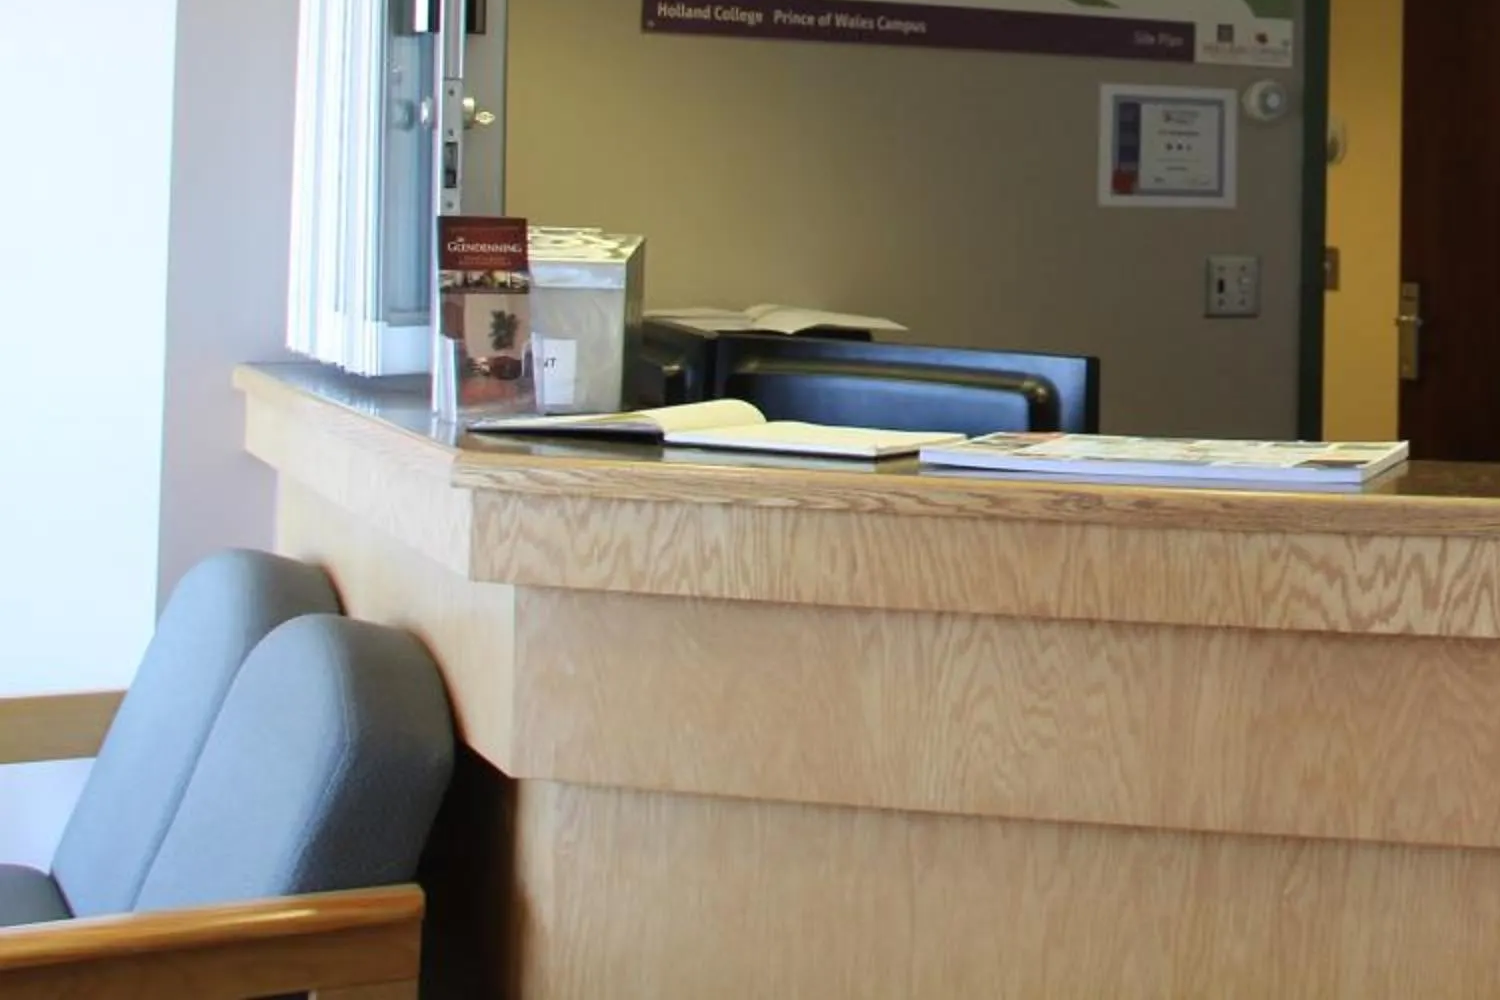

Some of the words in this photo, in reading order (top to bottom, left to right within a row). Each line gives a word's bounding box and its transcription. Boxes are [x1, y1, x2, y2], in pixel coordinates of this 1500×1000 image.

[656, 0, 712, 21] Holland
[713, 6, 764, 26] College
[773, 9, 815, 27] Prince
[816, 13, 832, 27] of
[834, 13, 876, 30] Wales
[876, 17, 928, 35] Campus
